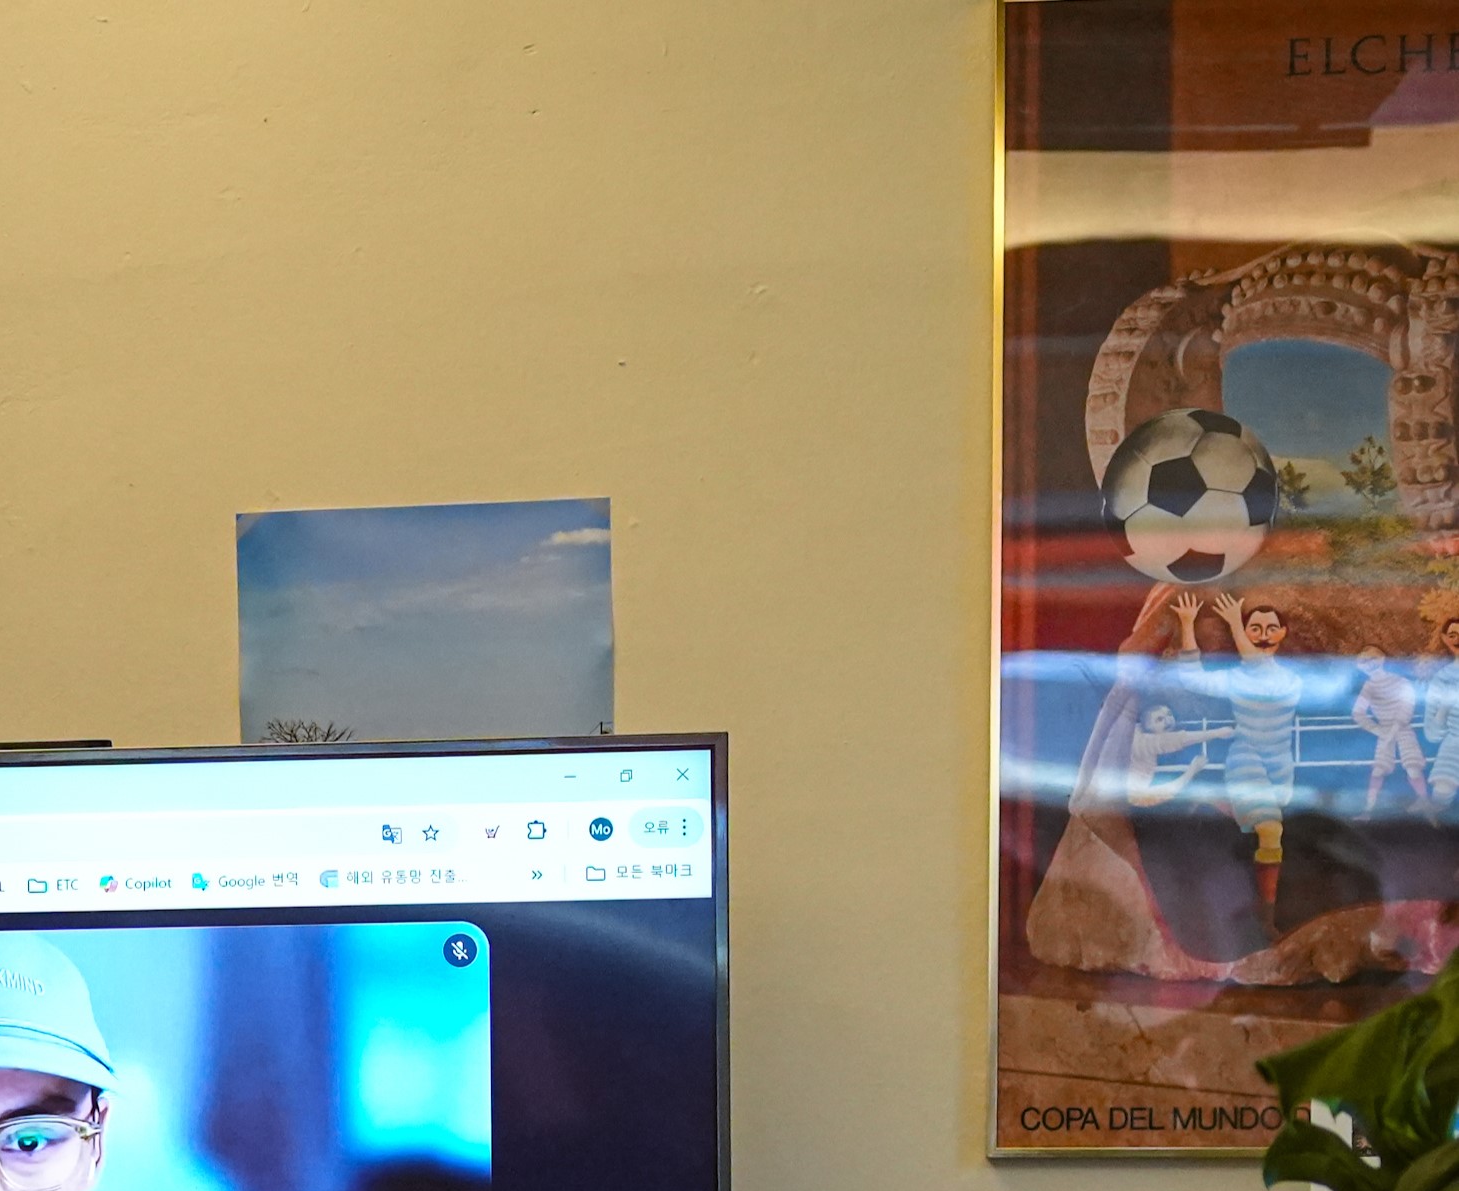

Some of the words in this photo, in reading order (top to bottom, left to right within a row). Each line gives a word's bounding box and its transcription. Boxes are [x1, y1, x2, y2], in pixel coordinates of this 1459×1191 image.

[591, 823, 611, 835] Mo
[643, 820, 669, 835] 오류
[346, 870, 373, 885] 해외
[616, 865, 643, 879] 모든
[651, 863, 693, 878] 북마크
[56, 879, 79, 892] ETC
[125, 876, 172, 892] Copilot
[218, 875, 266, 891] Google
[272, 871, 299, 888] 번역
[1020, 1106, 1100, 1131] COPA
[1108, 1106, 1165, 1131] DEL
[1172, 1106, 1283, 1131] MUNDO
